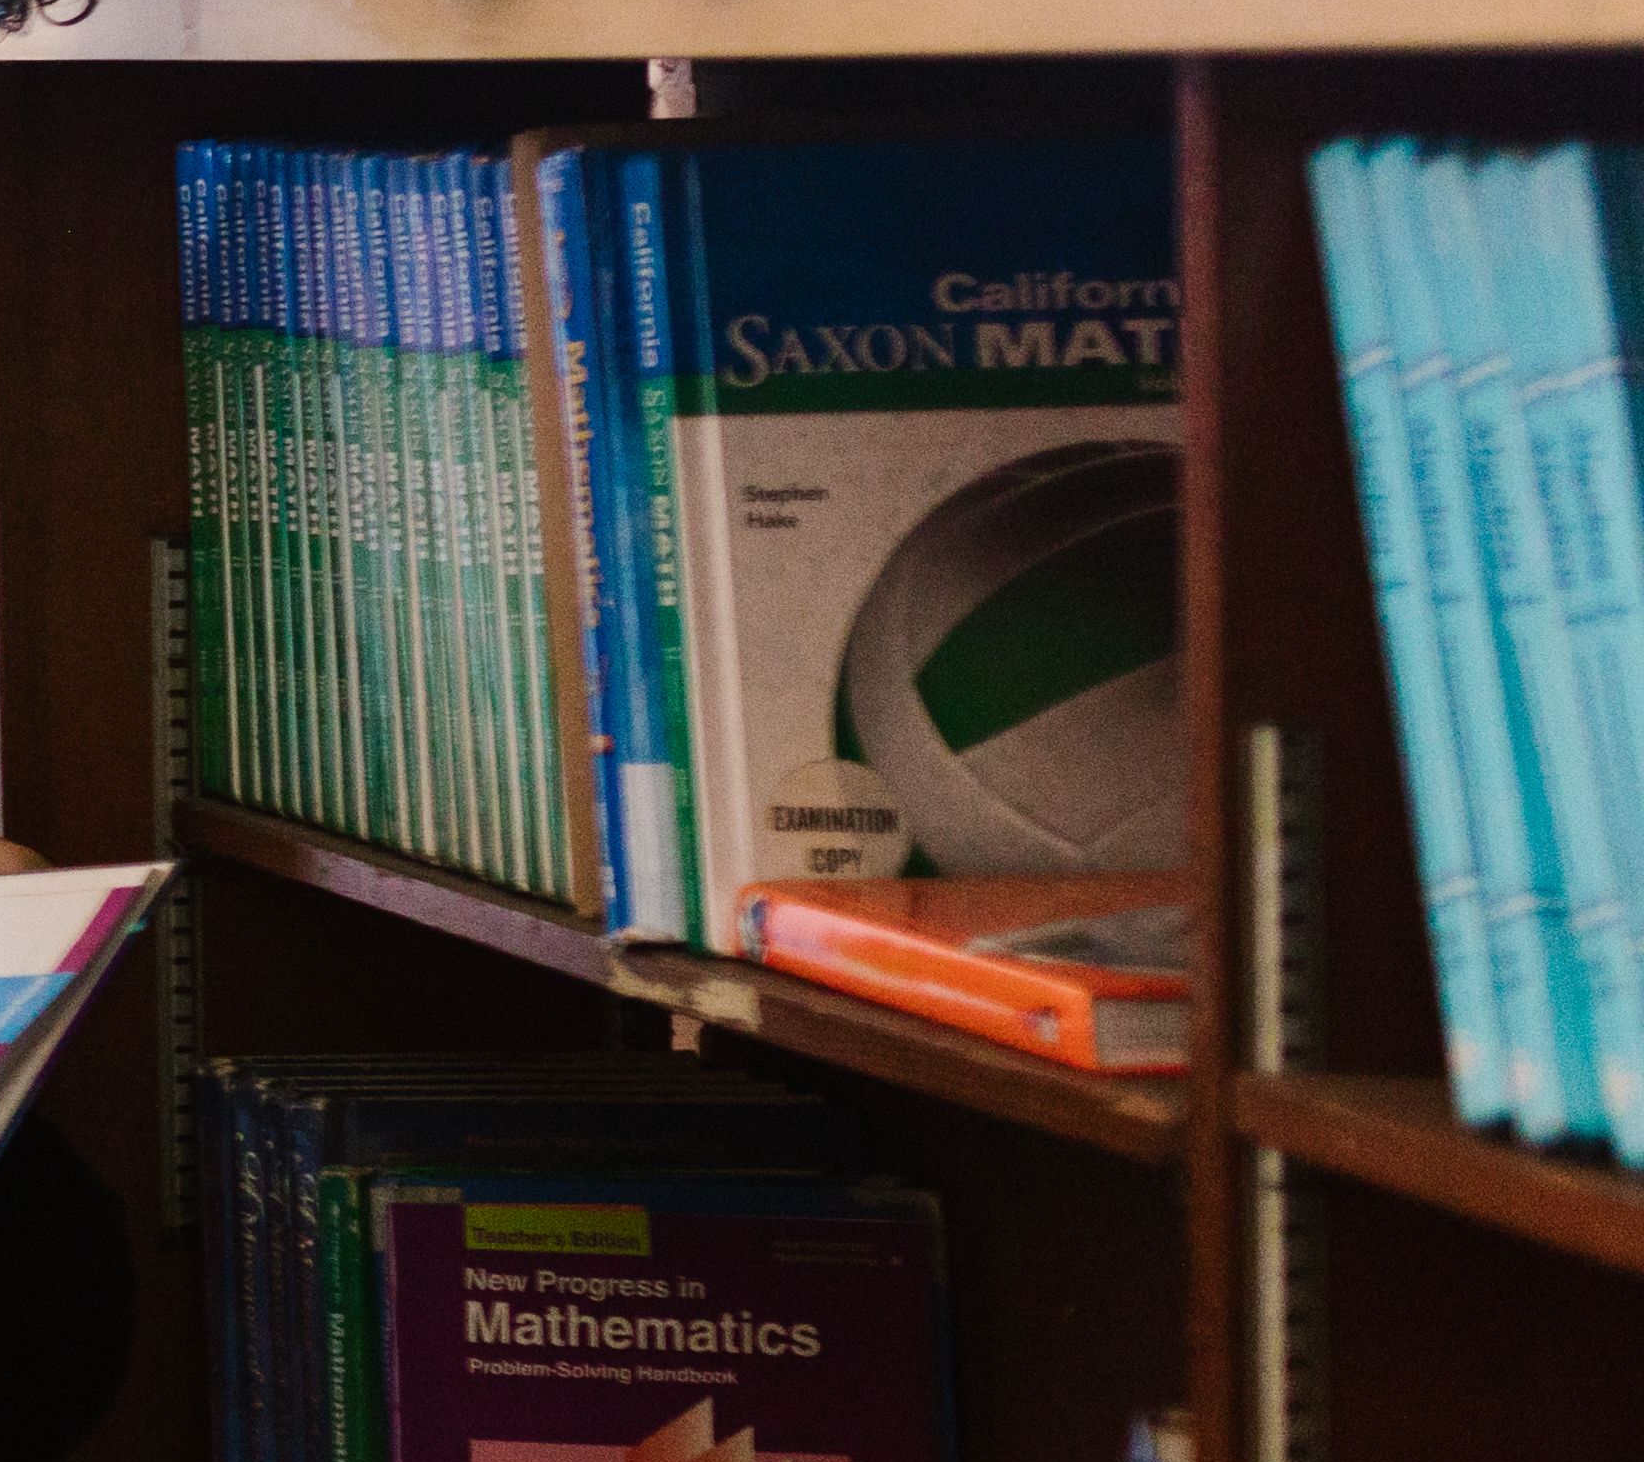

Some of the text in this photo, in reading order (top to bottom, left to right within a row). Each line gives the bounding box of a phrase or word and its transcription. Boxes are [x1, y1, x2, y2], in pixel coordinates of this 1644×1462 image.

[179, 184, 195, 321] California
[195, 179, 210, 316] California
[215, 184, 231, 322] California
[234, 180, 249, 319] California
[255, 180, 271, 319] California
[271, 185, 287, 326] California
[368, 190, 388, 337] California
[452, 190, 476, 342] California
[474, 197, 503, 352] California
[932, 272, 1182, 312] Californ
[630, 201, 661, 369] California
[652, 494, 677, 607] MATH
[723, 314, 1173, 389] SAXON MAT
[772, 805, 899, 834] EXAMINATION
[811, 847, 862, 873] COPY
[465, 1267, 707, 1301] New Progress in
[465, 1299, 821, 1357] Mathematics
[469, 1357, 739, 1385] Problem-Solving Handbook
